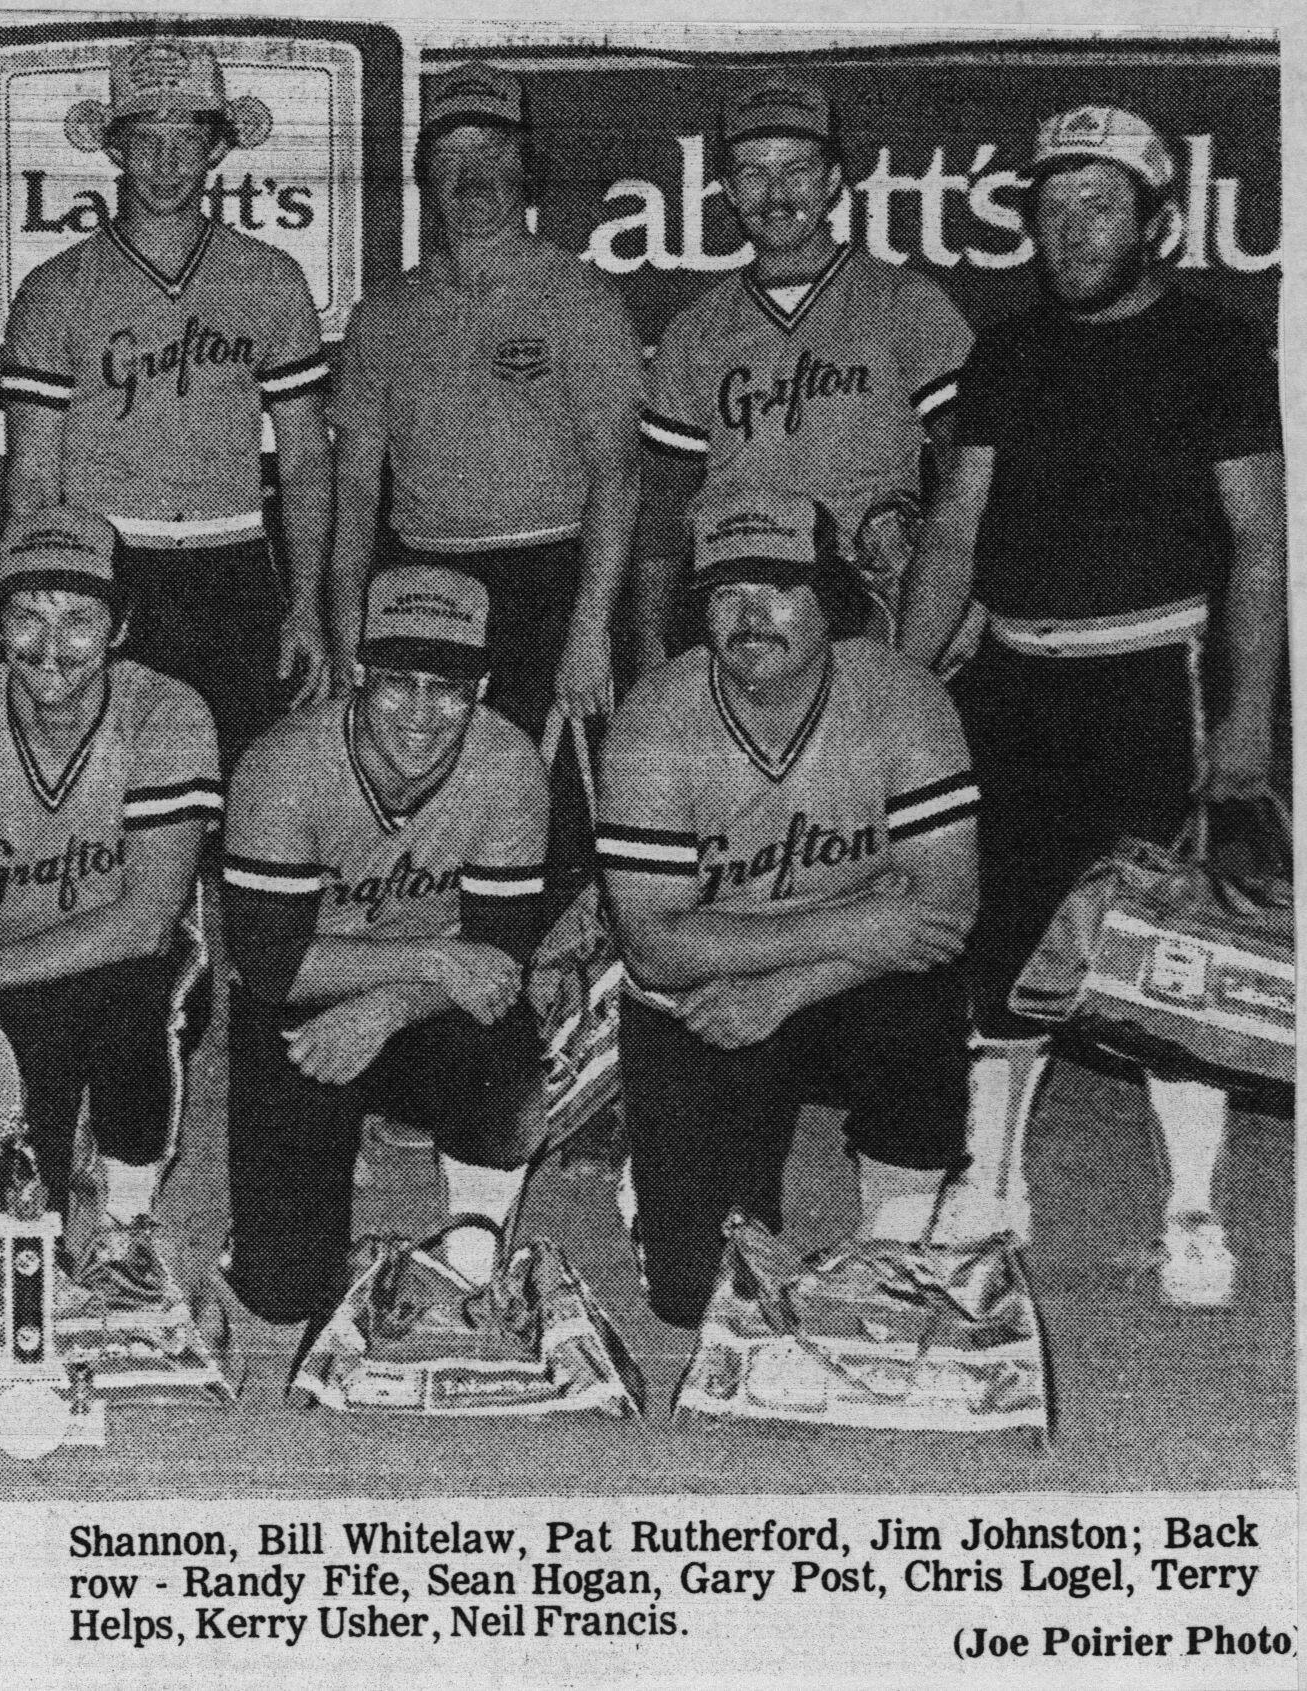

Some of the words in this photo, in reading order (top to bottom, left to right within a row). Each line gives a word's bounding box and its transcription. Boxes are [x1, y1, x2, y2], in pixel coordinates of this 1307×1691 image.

[20, 169, 314, 233] Latt's
[525, 134, 1034, 273] abtt's
[102, 315, 256, 421] Grafton
[70, 1525, 237, 1562] Shannon,
[259, 1522, 323, 1555] Bill
[343, 1521, 526, 1560] Whitelaw,
[547, 1522, 611, 1553] Pat
[632, 1518, 850, 1557] Rutherford,
[871, 1518, 941, 1550] Jim
[961, 1517, 1141, 1555] Johnston;
[1165, 1515, 1258, 1549] Back
[71, 1575, 138, 1599] row
[184, 1564, 305, 1604] Randy
[324, 1563, 409, 1602] Fife,
[428, 1564, 515, 1596] Sean
[533, 1563, 661, 1602] Hogan,
[681, 1562, 774, 1601] Gary
[793, 1561, 886, 1598] Post,
[905, 1560, 1002, 1592] Chris
[1021, 1558, 1134, 1598] Logel,
[1151, 1559, 1258, 1596] Terry
[70, 1607, 186, 1647] Helps,
[195, 1608, 307, 1647] Kerry
[318, 1606, 441, 1643] Usher,
[450, 1605, 525, 1637] Neil
[534, 1604, 689, 1637] Francis.
[953, 1627, 1029, 1660] (Joe
[1042, 1626, 1173, 1657] Poirier
